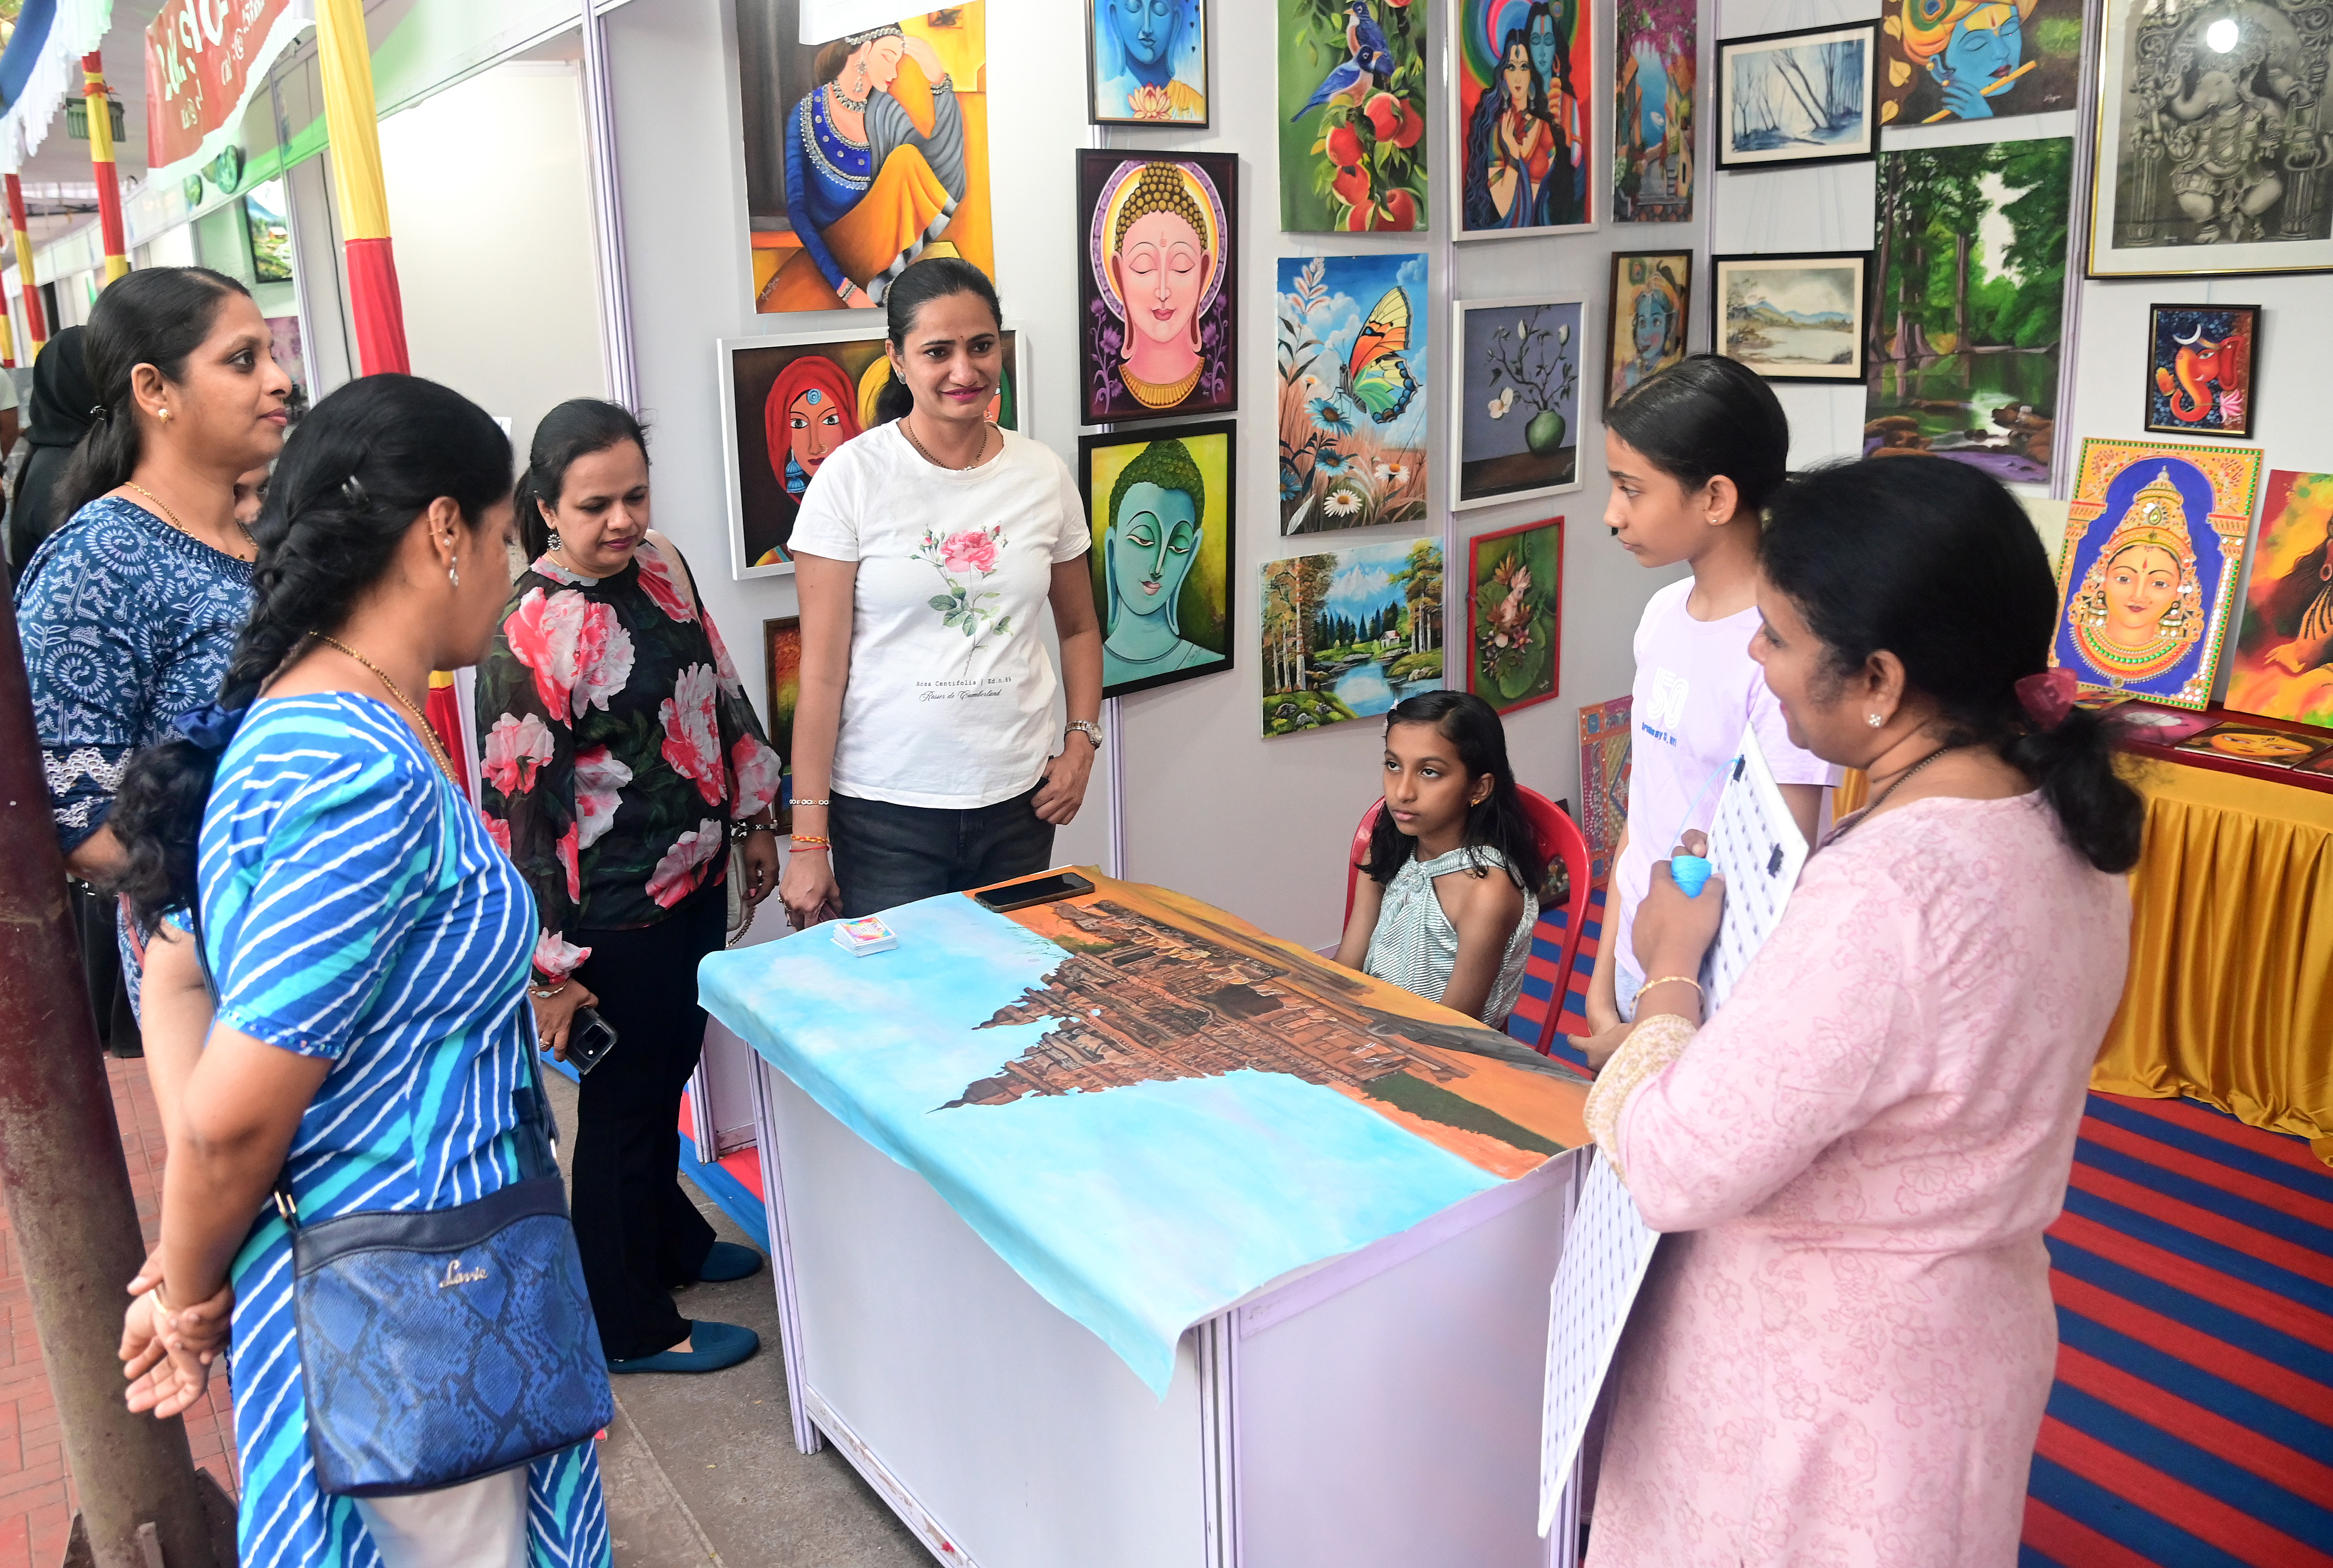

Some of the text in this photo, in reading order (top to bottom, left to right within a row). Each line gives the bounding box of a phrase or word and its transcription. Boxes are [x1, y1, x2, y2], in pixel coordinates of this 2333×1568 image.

[958, 689, 1003, 700] Cumberland
[1647, 667, 1689, 730] 50
[439, 1260, 488, 1288] Lavie
